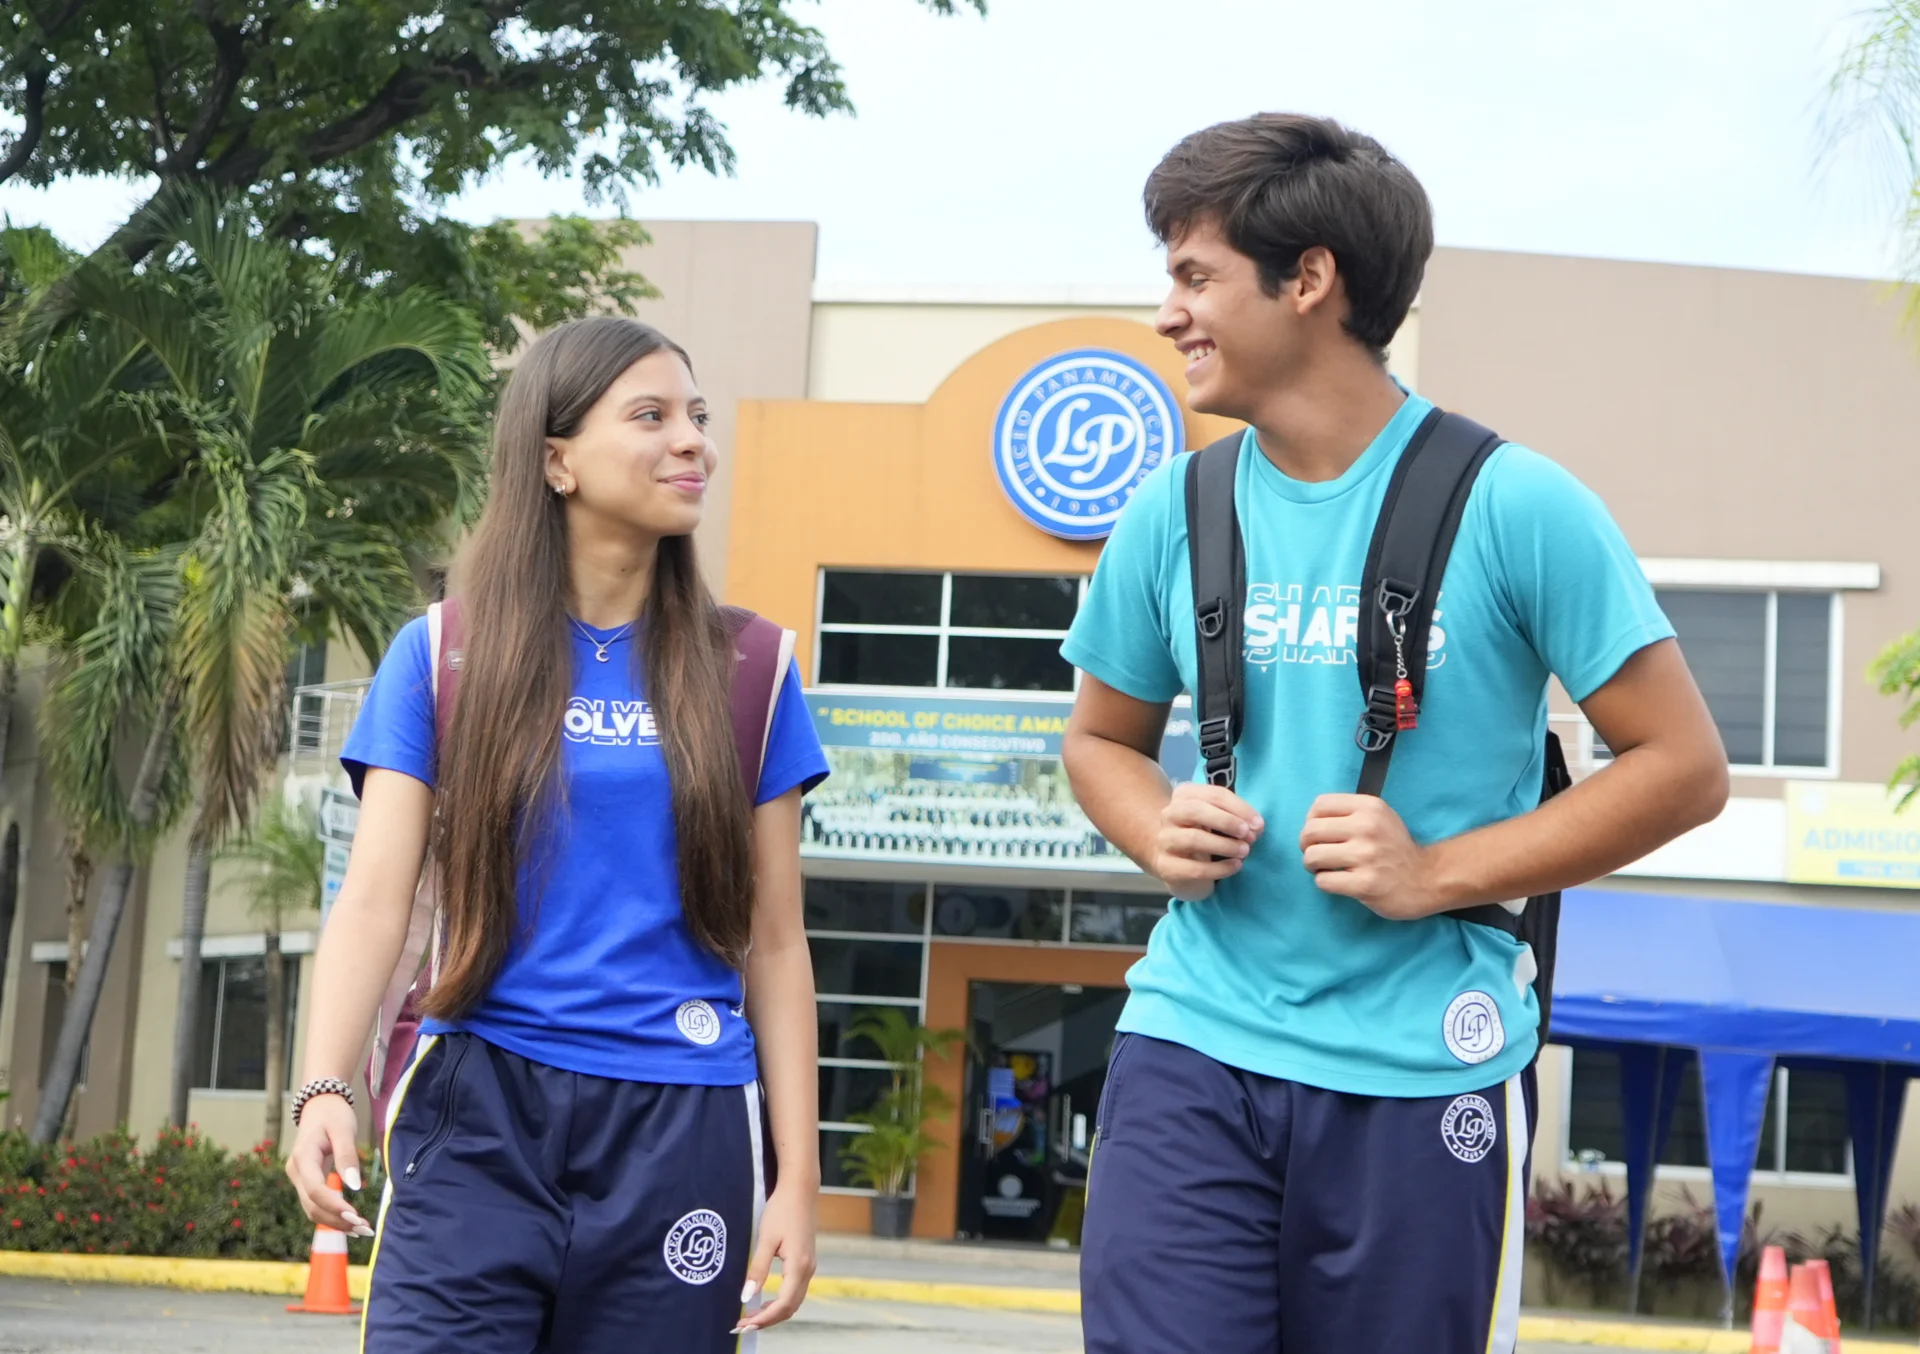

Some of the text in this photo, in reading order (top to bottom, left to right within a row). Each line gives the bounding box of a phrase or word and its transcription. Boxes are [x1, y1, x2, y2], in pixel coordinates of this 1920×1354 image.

[1032, 368, 1163, 483] PANAMERICANO
[1243, 603, 1446, 652] SHARS
[913, 711, 939, 729] OF
[943, 713, 1016, 733] CHOICE
[1019, 715, 1070, 735] AWA
[941, 734, 1046, 753] CONSECUTIVO
[668, 1214, 724, 1268] LICEO PANAMERICANO
